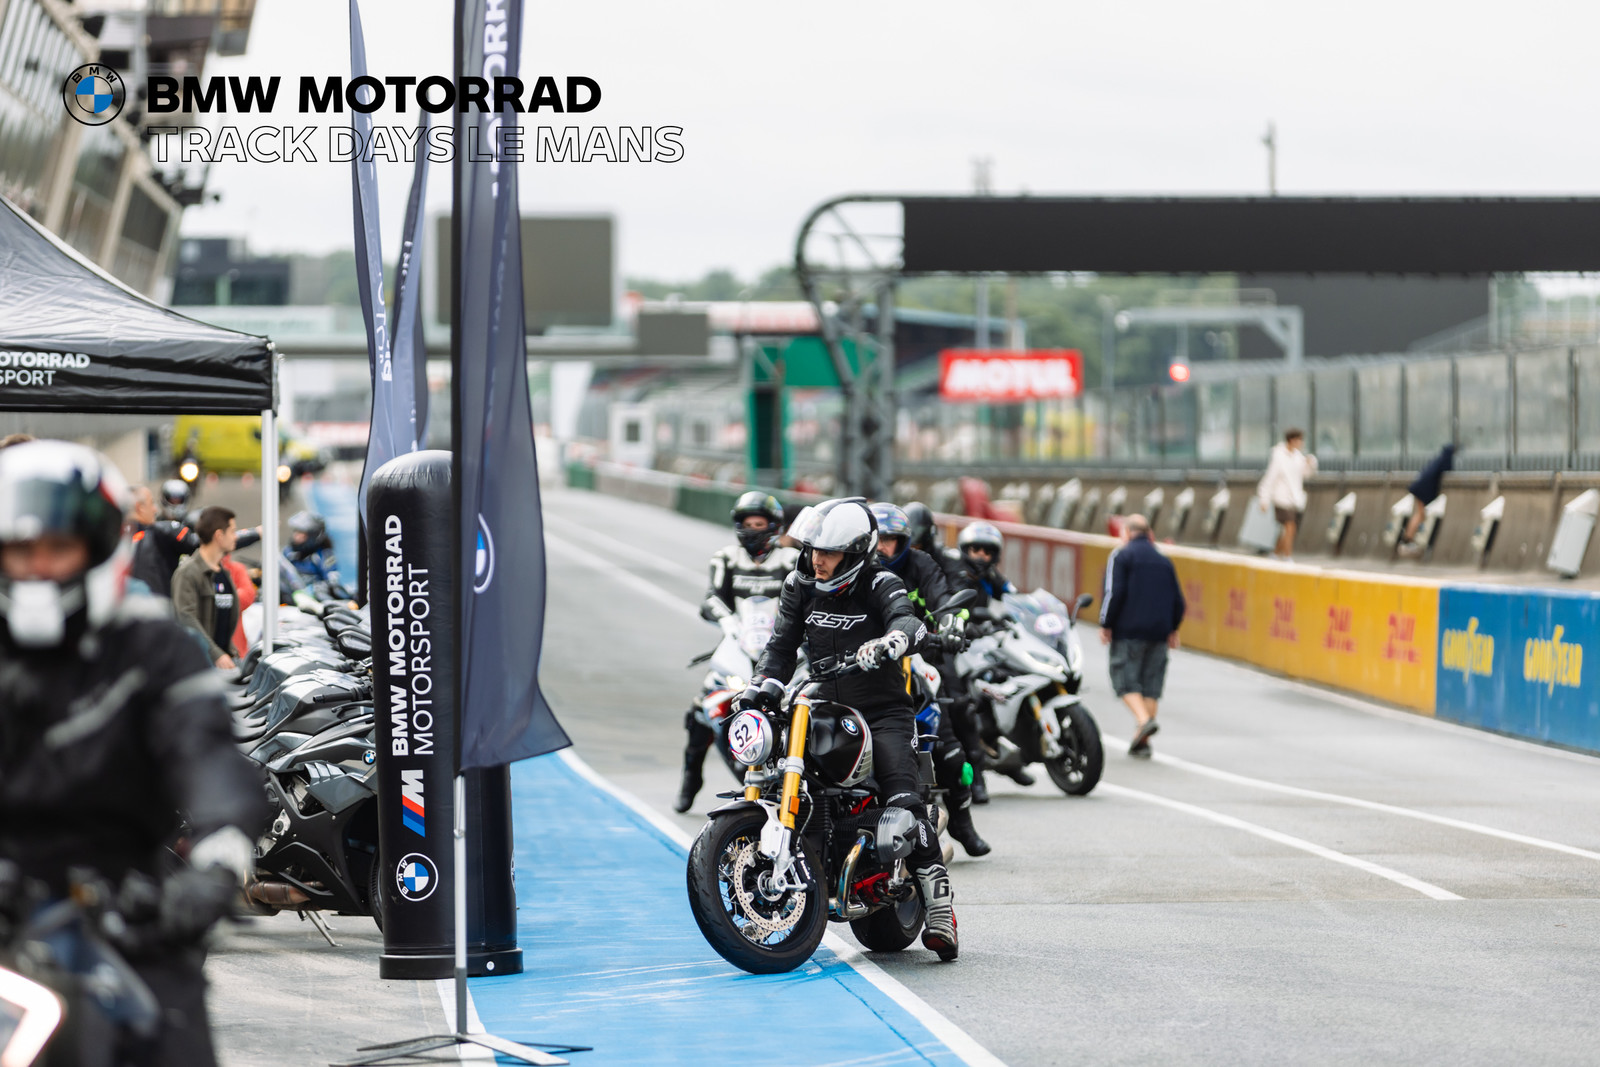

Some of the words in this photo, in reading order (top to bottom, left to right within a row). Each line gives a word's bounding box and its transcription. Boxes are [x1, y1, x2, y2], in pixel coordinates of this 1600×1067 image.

[945, 358, 1078, 394] MOTUL
[385, 514, 407, 676] MOTORRAD
[805, 611, 868, 630] RST
[407, 563, 434, 755] MOTORSPORT
[390, 685, 409, 756] BMW
[734, 723, 753, 748] 52
